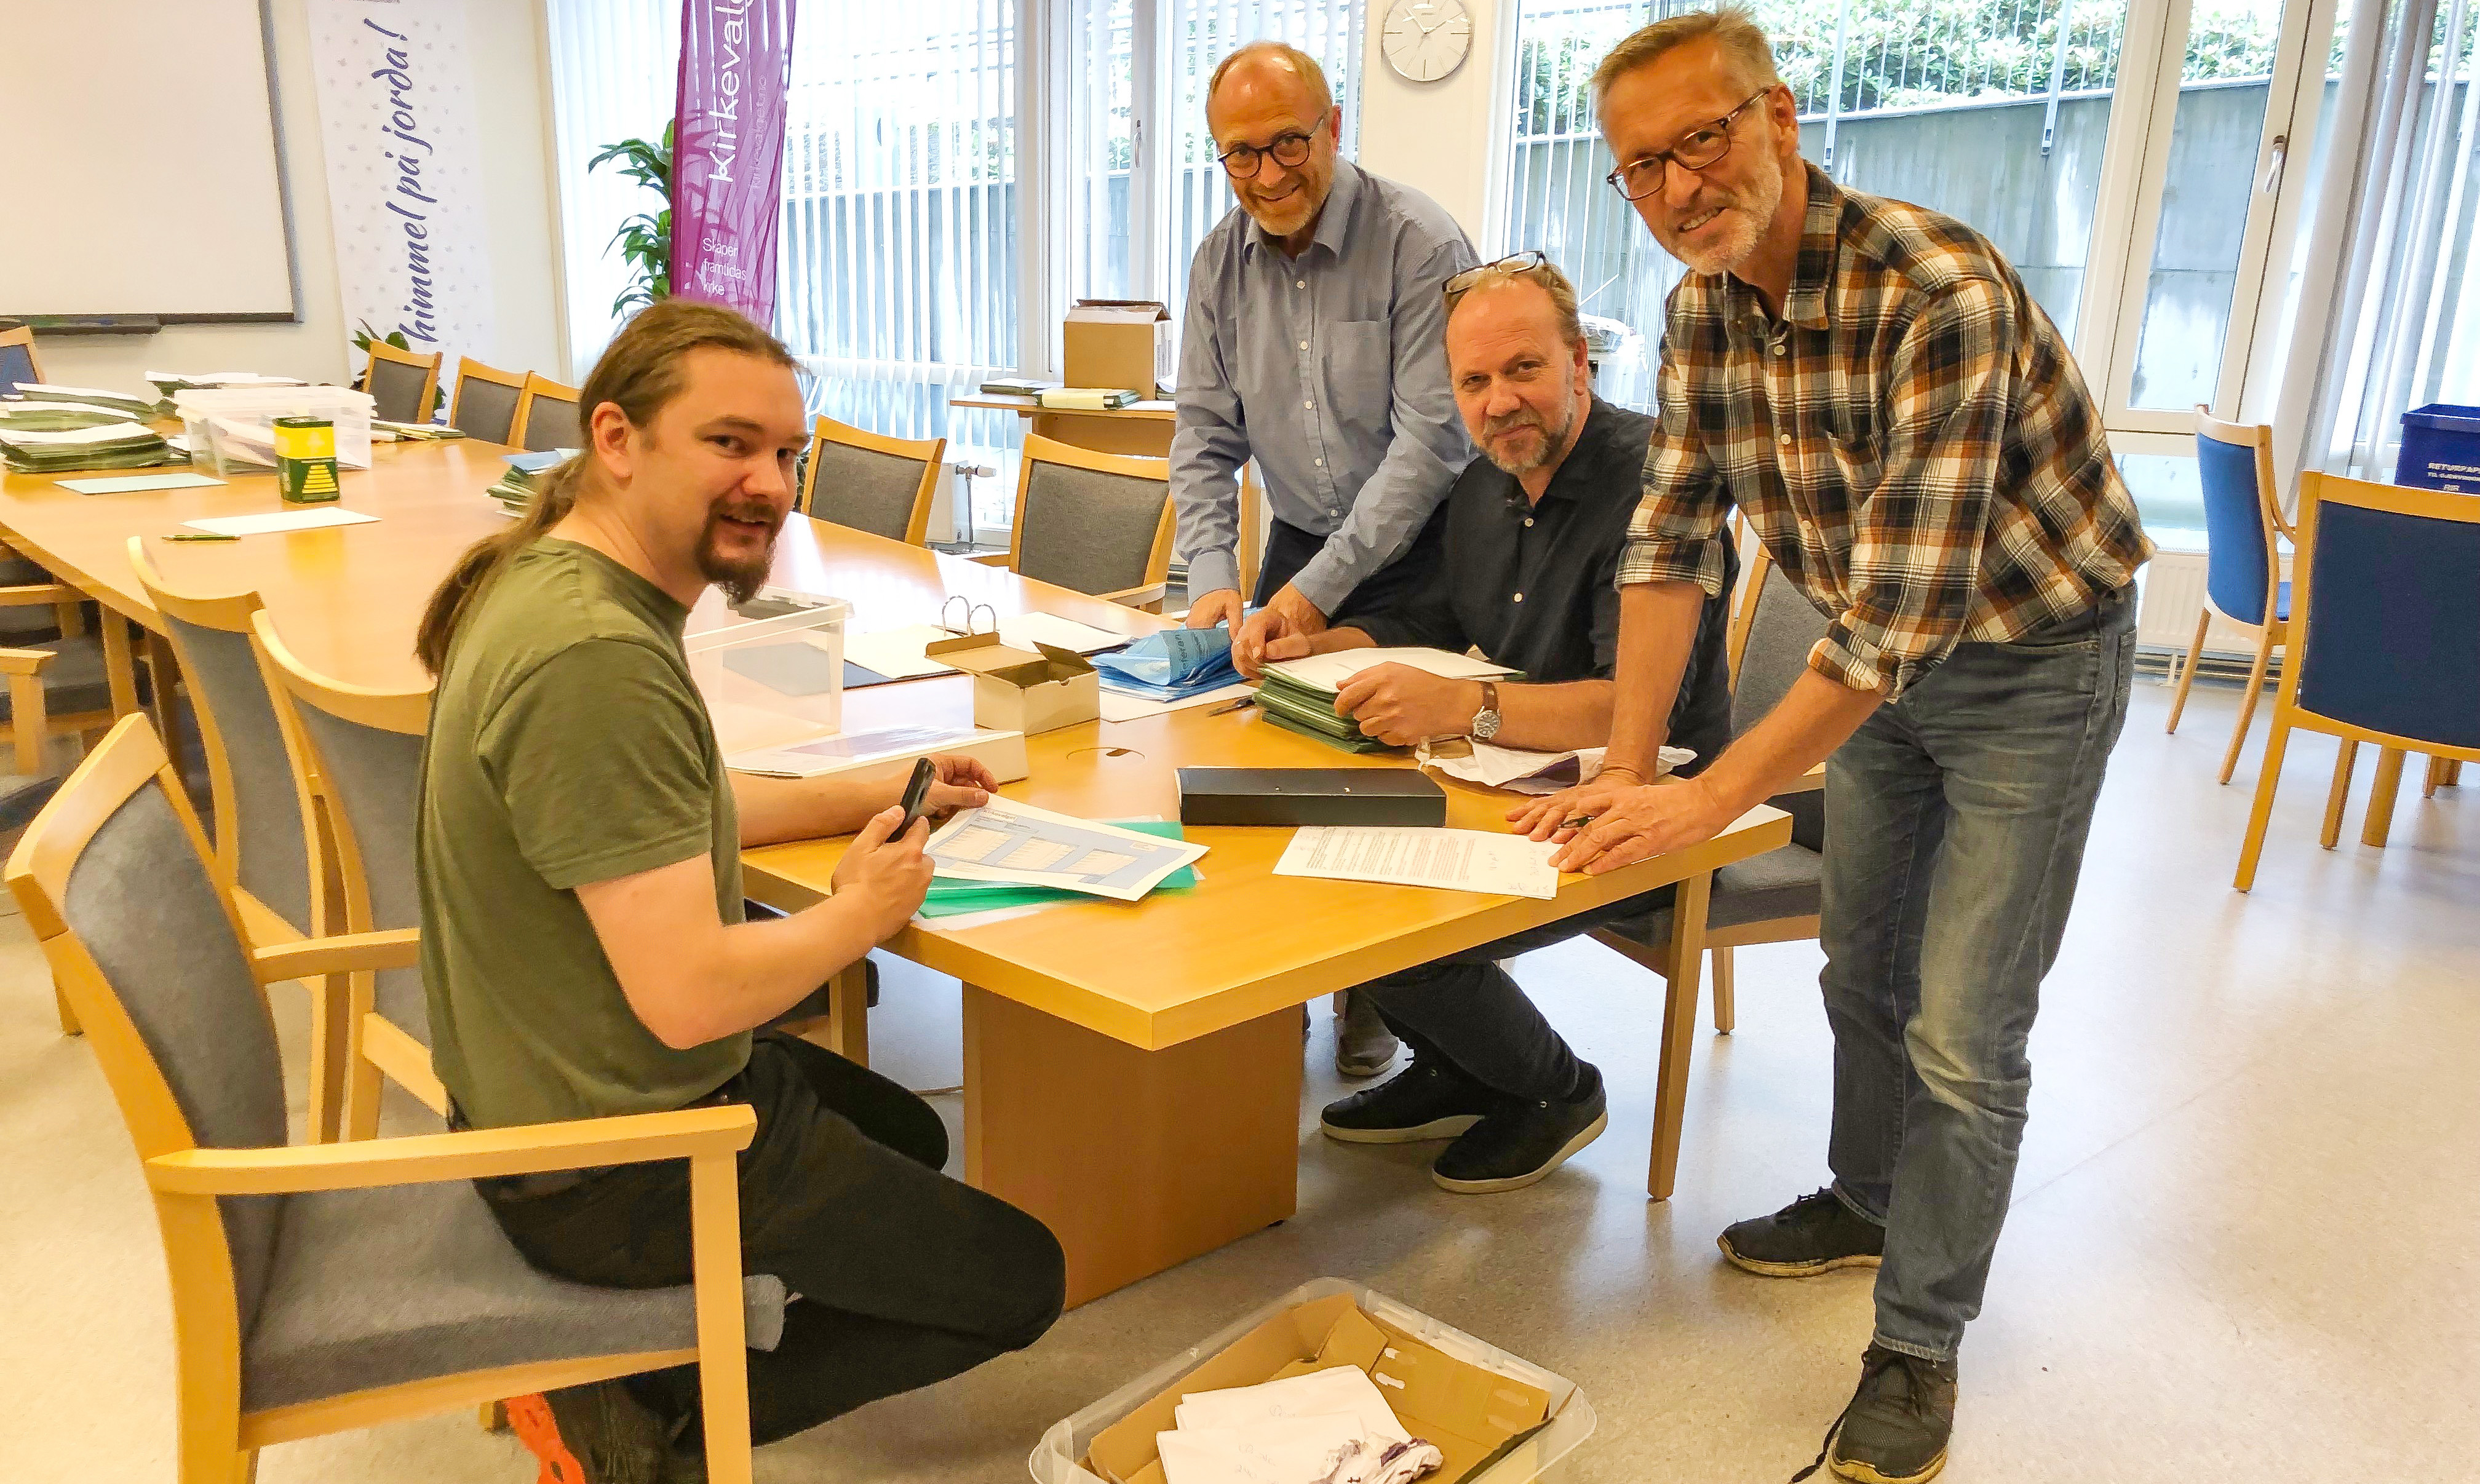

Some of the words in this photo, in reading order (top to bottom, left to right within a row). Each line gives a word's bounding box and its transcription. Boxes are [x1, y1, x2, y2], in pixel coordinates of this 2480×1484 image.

[708, 0, 753, 183] Kirkeval
[385, 152, 437, 203] på
[386, 201, 439, 342] himmel
[703, 237, 738, 257] Skaper
[703, 258, 746, 280] framtidas
